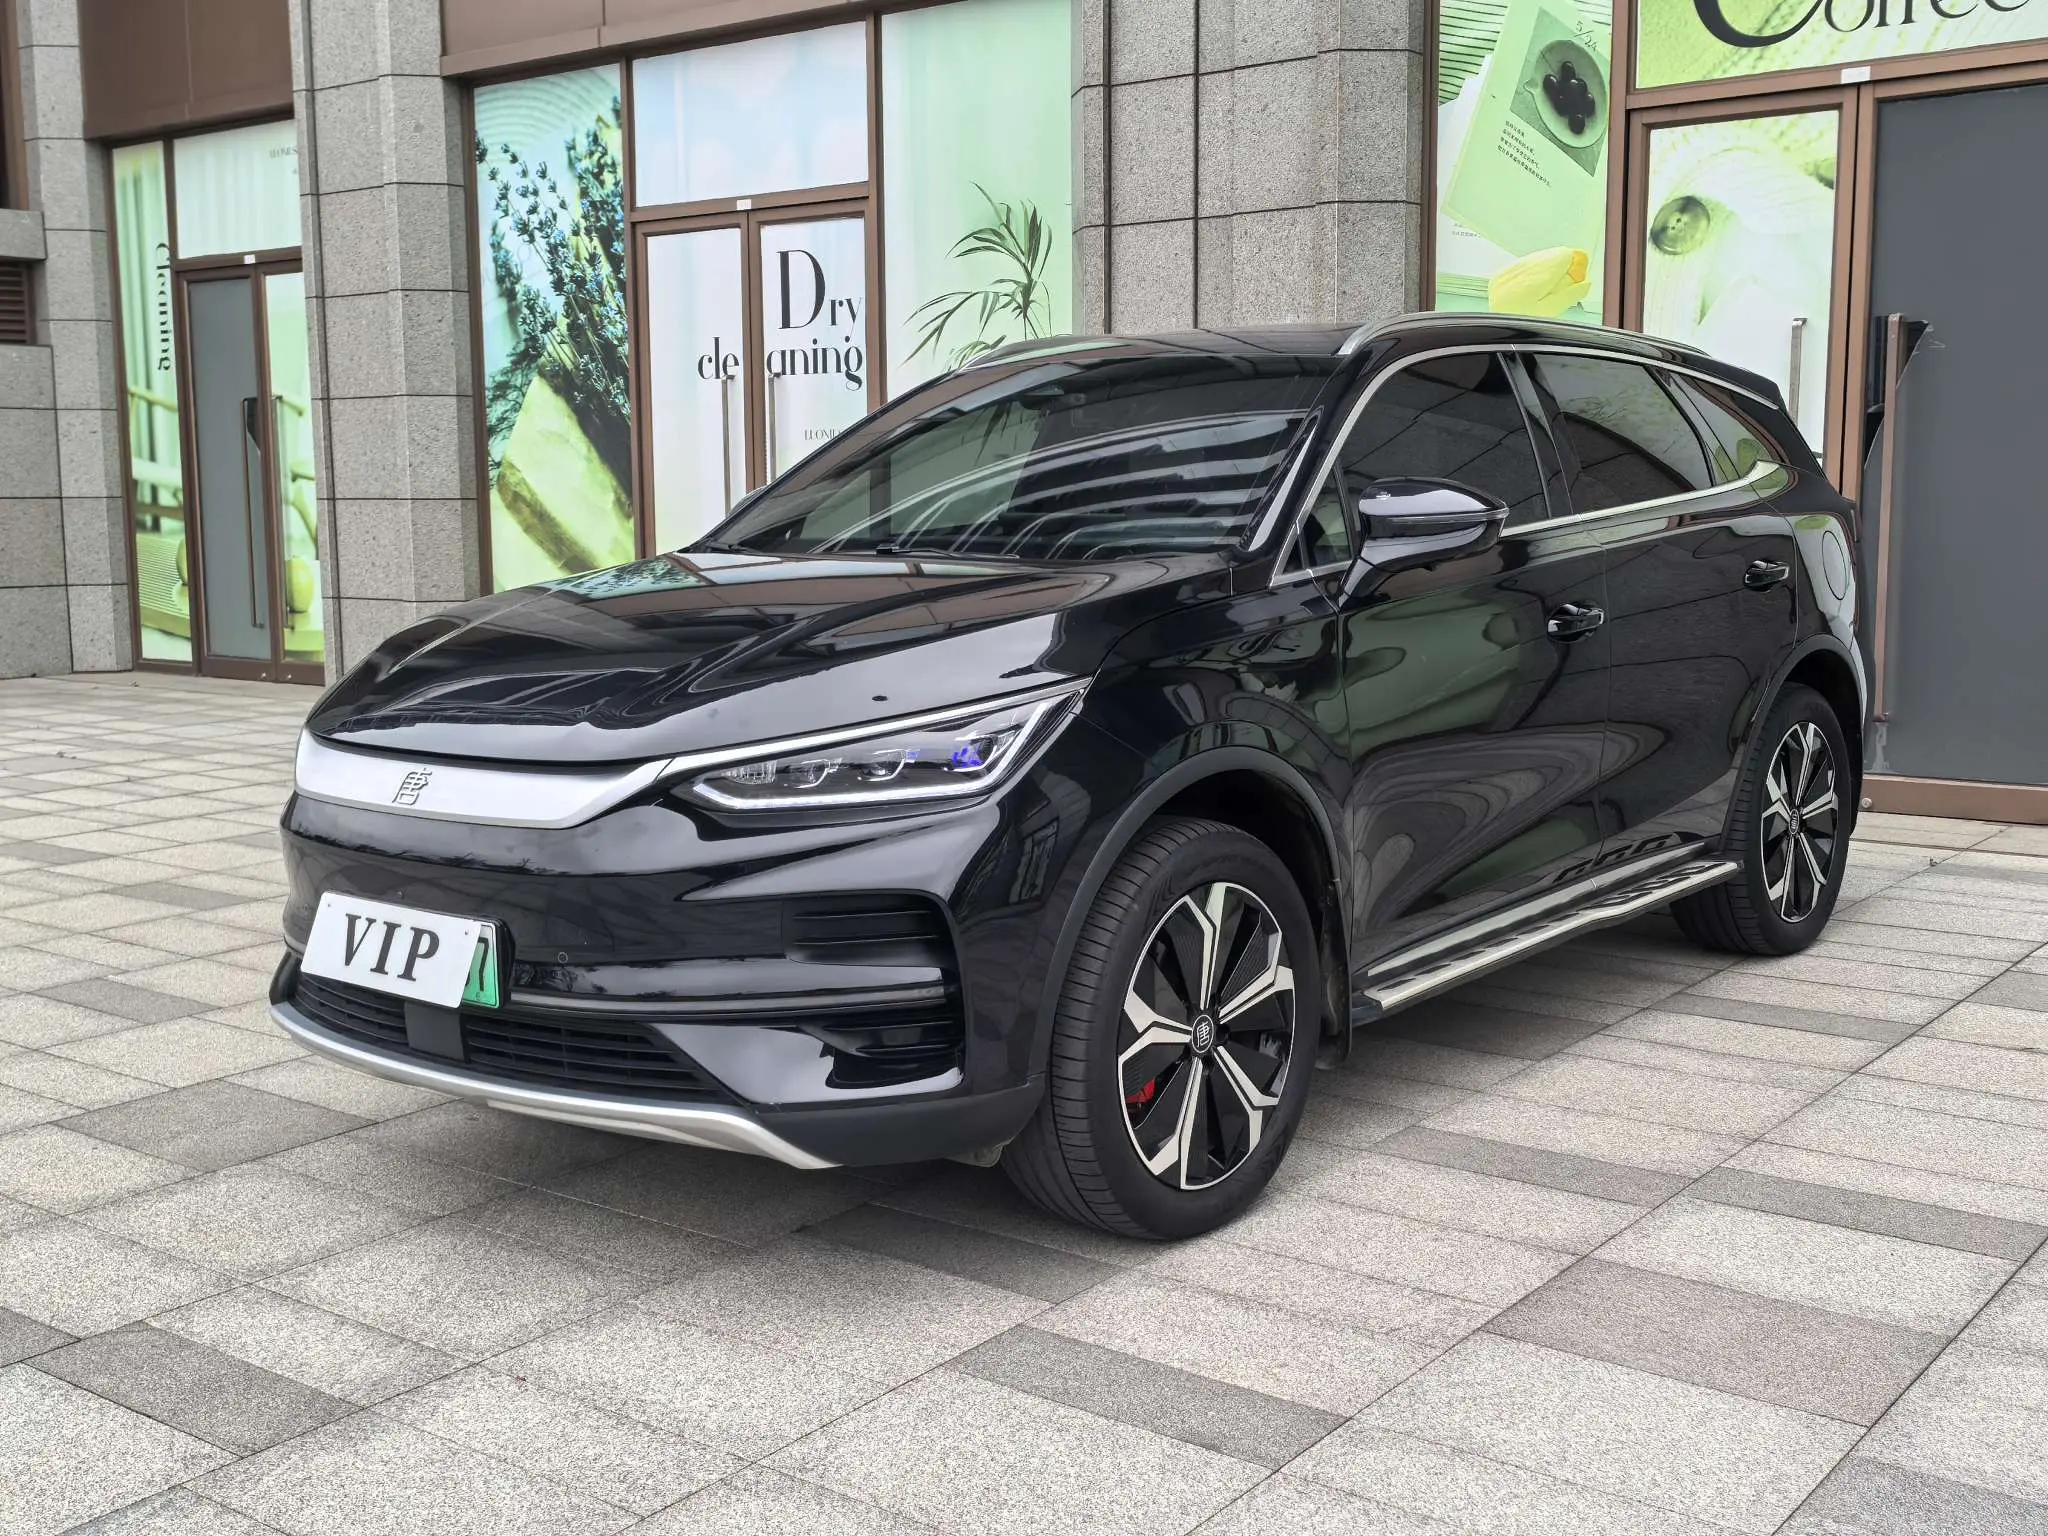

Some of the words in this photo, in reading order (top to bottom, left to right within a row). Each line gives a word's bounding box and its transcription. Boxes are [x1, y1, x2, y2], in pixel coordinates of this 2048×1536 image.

[155, 242, 171, 371] Cleaning
[775, 249, 863, 338] Dry
[344, 912, 441, 982] VIP
